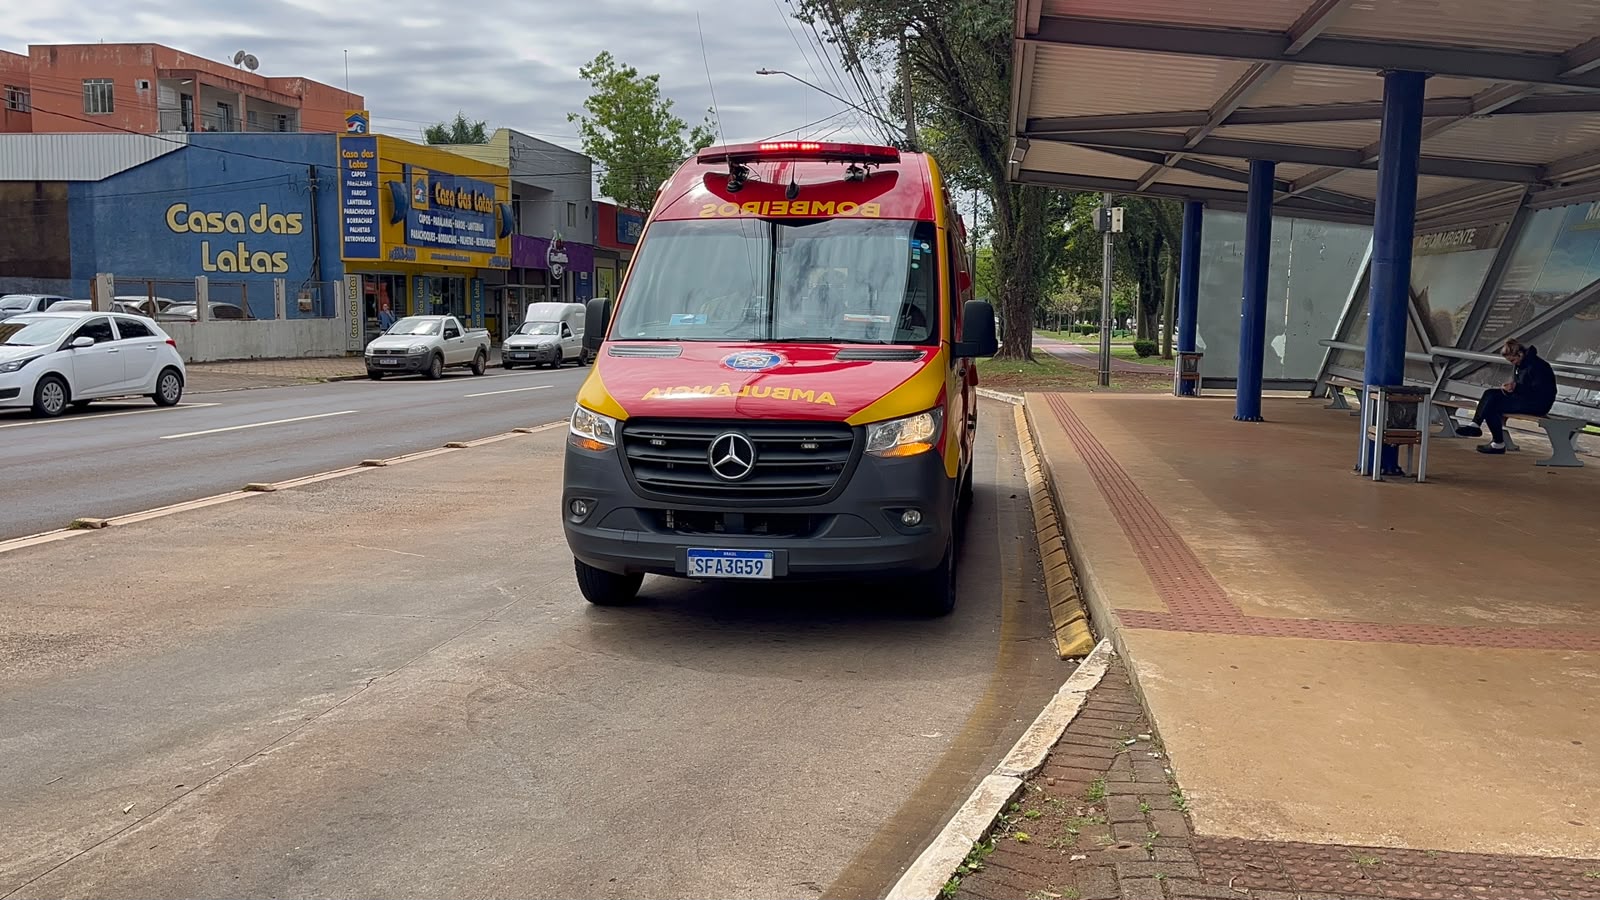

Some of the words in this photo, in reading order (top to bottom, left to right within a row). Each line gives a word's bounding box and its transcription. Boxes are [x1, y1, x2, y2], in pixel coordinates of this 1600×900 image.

[343, 149, 359, 158] Casa
[361, 149, 374, 158] das
[349, 160, 368, 169] Latas
[435, 181, 456, 207] Casa
[457, 187, 472, 210] das
[474, 189, 494, 214] Latas
[166, 203, 246, 234] Casa
[249, 203, 303, 234] das
[344, 235, 376, 243] RETROVISORES
[200, 240, 289, 273] Latas
[349, 276, 358, 299] Latas
[695, 558, 763, 575] SFA3G59
